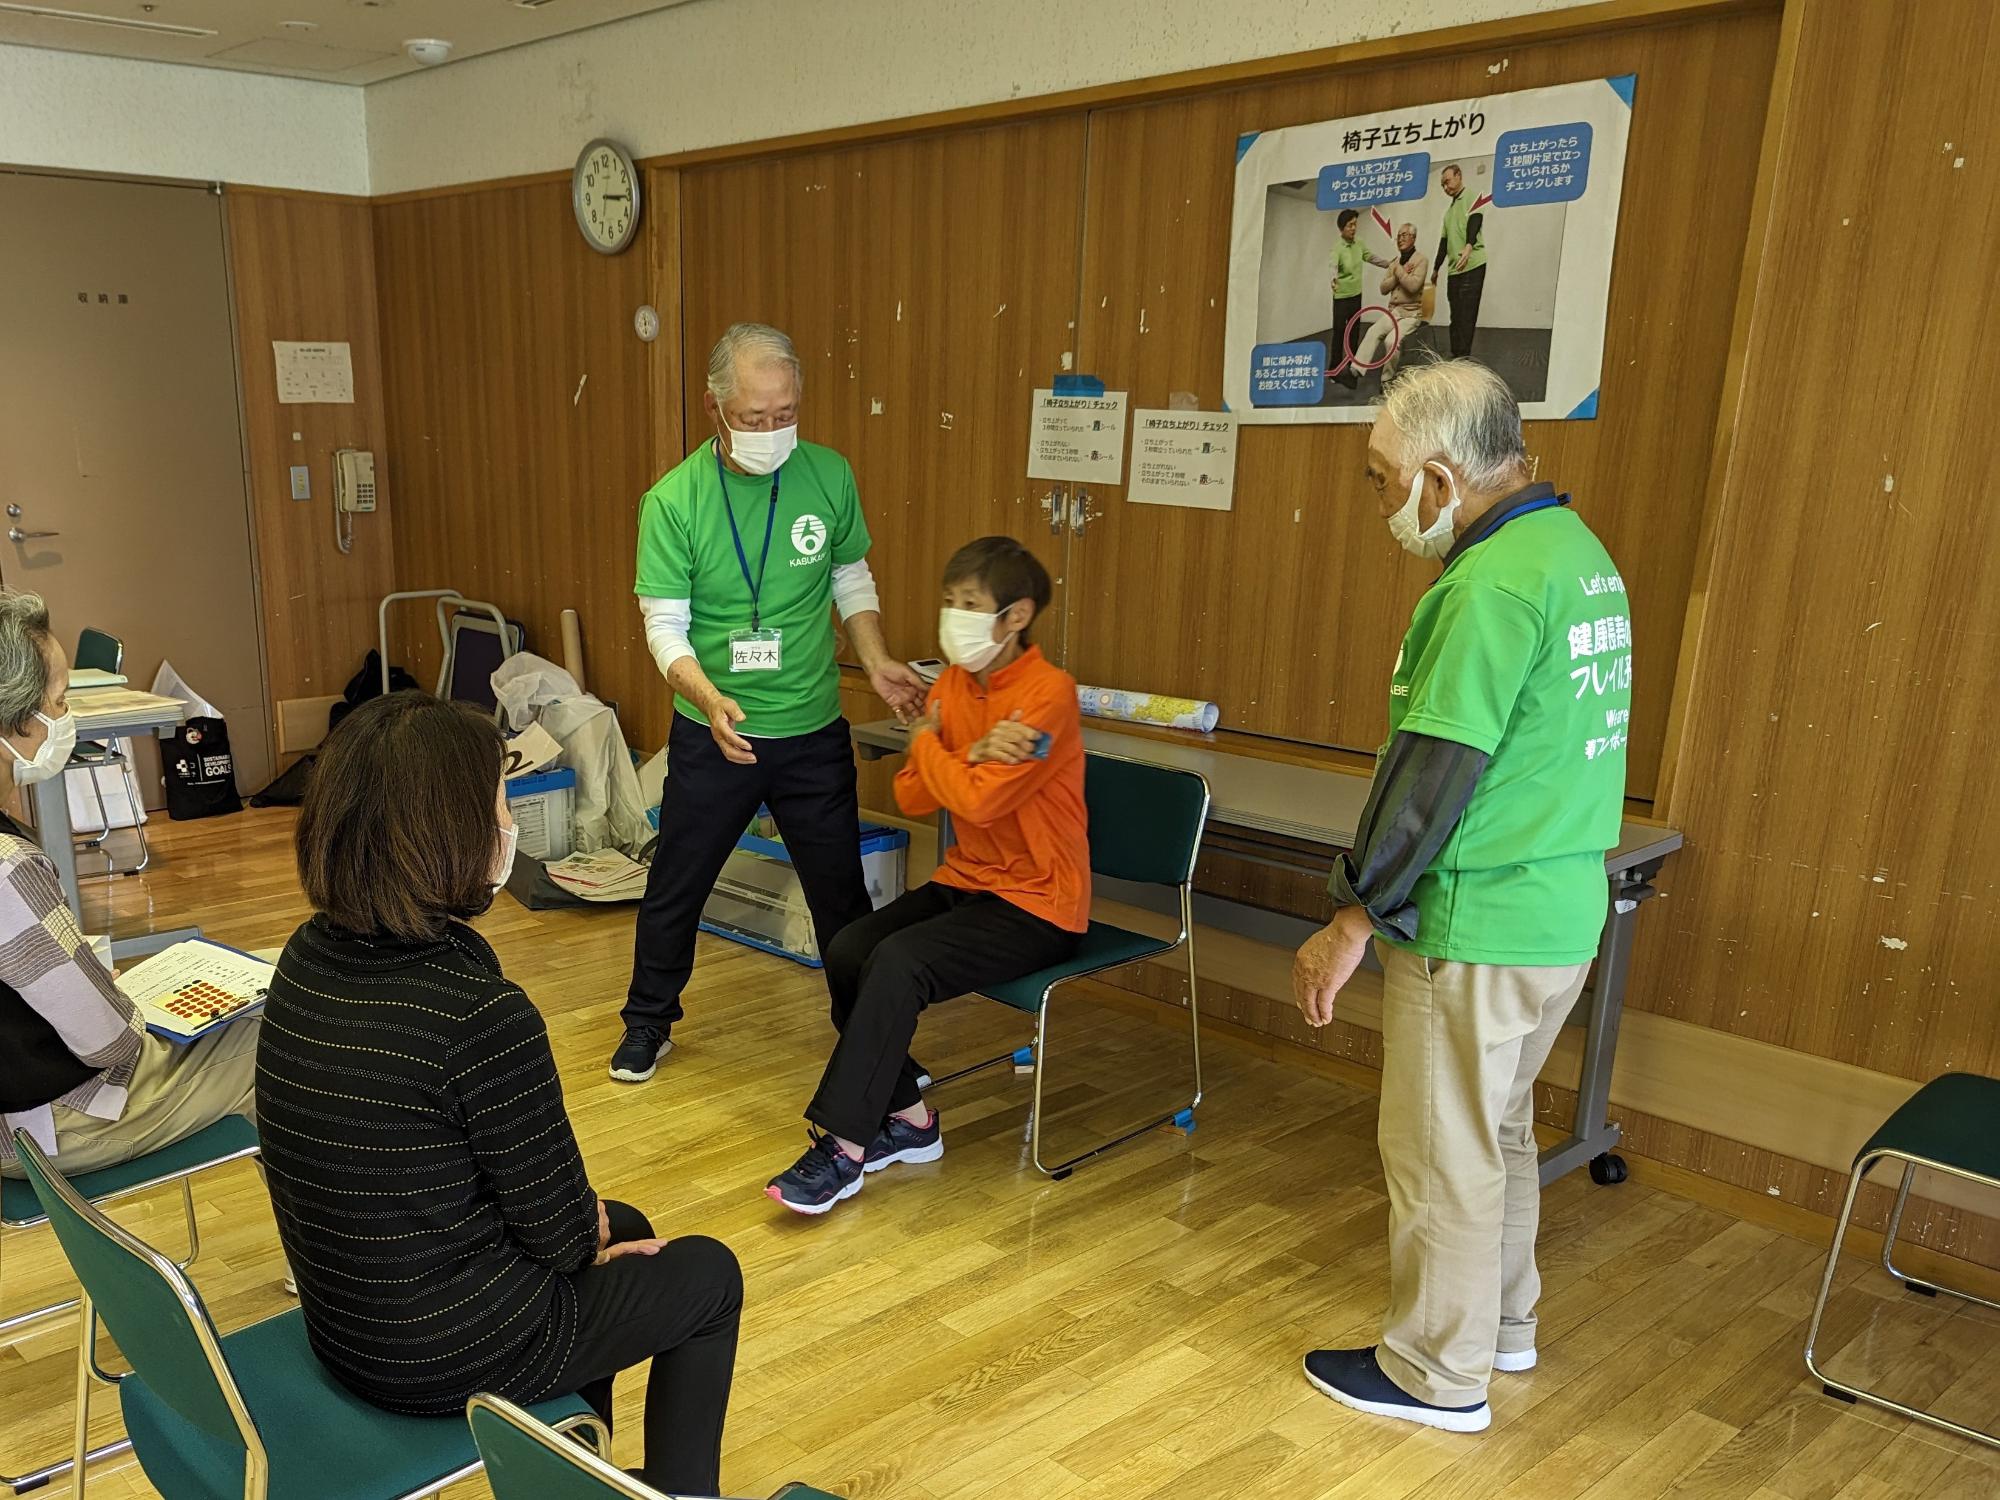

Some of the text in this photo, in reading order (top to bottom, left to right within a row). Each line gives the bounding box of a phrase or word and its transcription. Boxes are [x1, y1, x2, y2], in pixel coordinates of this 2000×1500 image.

[1341, 112, 1485, 153] 椅子立ち上がり
[1509, 136, 1578, 154] 立ち上がったら
[593, 161, 600, 174] 11
[601, 154, 609, 168] 12
[613, 158, 617, 171] 1
[621, 170, 627, 183] 2
[1512, 163, 1571, 178] ていられるか
[586, 174, 595, 188] 10
[1332, 171, 1414, 191] ゆっくりと椅子から
[1505, 174, 1574, 191] チェックします
[585, 193, 591, 206] 9
[1339, 186, 1403, 203] 立ち上がります
[591, 210, 597, 223] 8
[624, 206, 629, 219] 4
[599, 221, 604, 235] 7
[608, 226, 614, 239] 6
[618, 220, 623, 233] 5
[1579, 571, 1607, 596] Let's
[735, 650, 777, 664] 佐々木
[205, 763, 232, 777] GOALS
